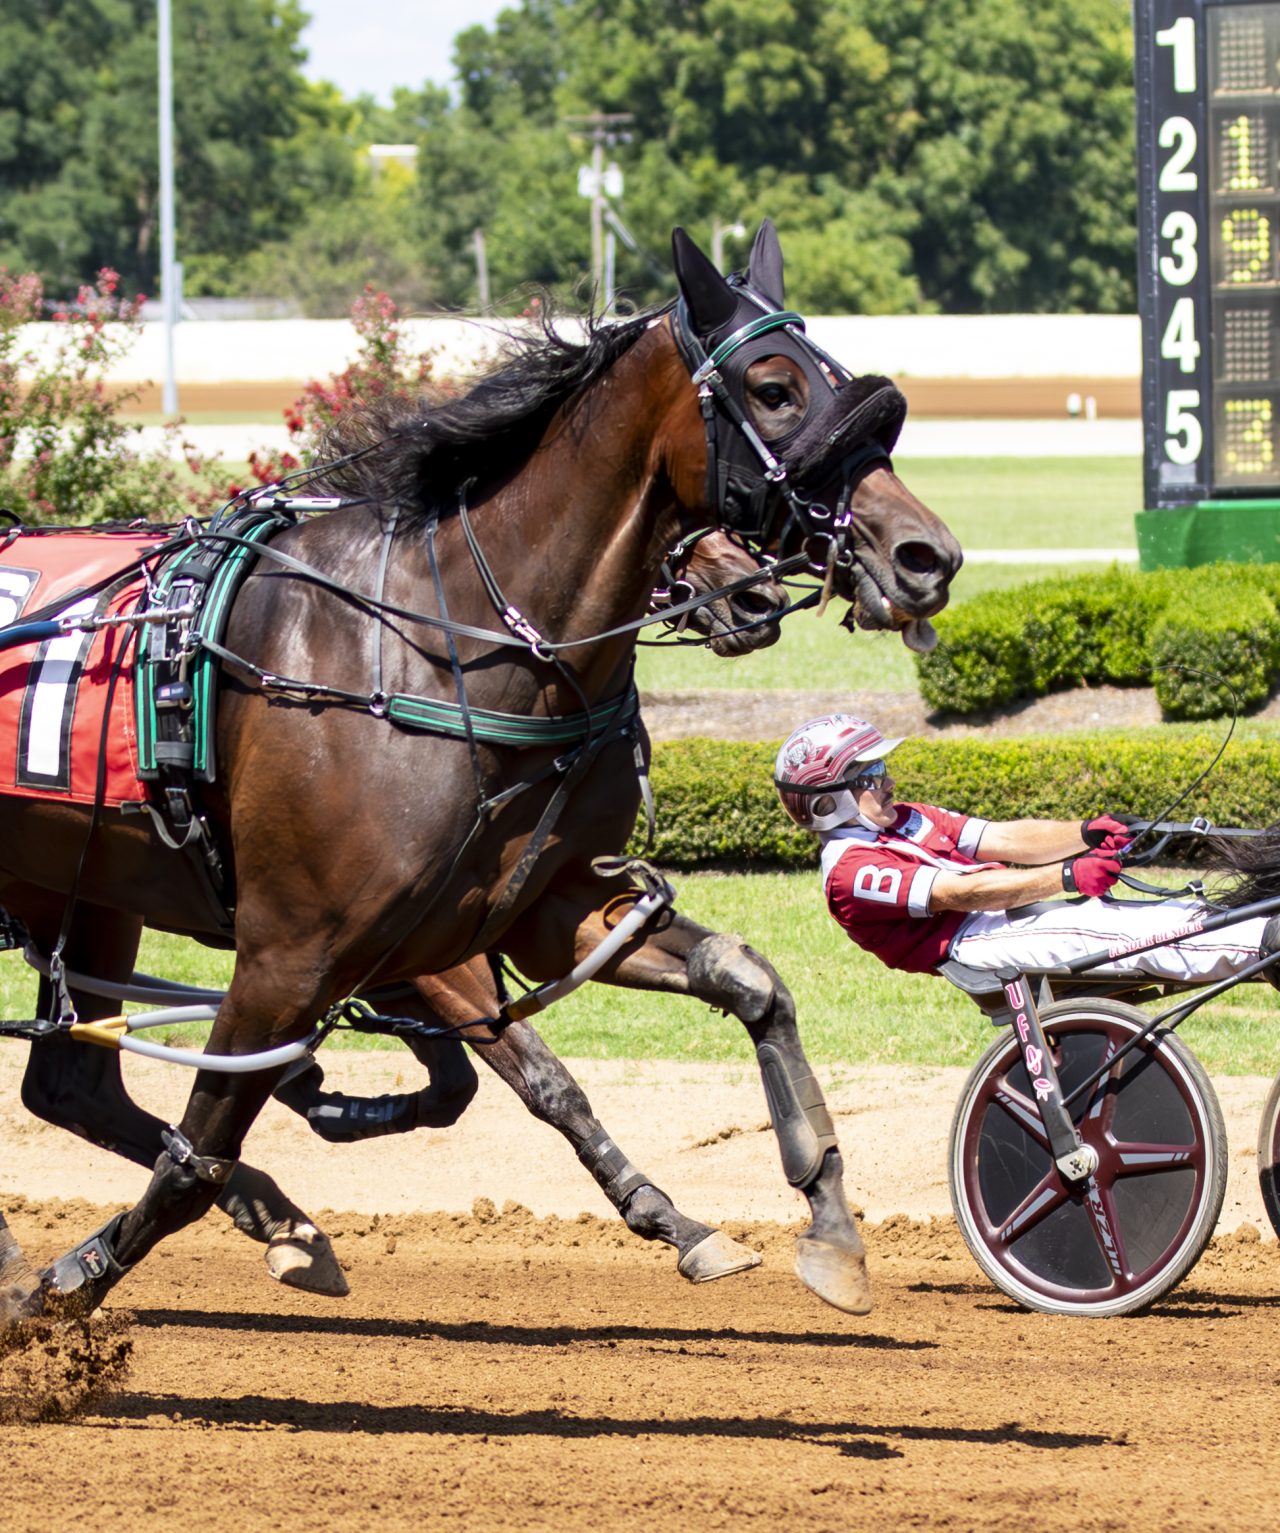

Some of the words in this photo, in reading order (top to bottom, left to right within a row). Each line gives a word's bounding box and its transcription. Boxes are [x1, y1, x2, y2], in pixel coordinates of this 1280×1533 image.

[1155, 17, 1196, 92] 1
[1158, 116, 1197, 191] 2
[1228, 115, 1258, 190] 1
[1160, 211, 1198, 285] 3
[1221, 208, 1269, 282] 9
[1161, 297, 1201, 373] 4
[1164, 390, 1202, 464] 5
[1225, 399, 1273, 472] 3
[27, 597, 100, 776] 1
[853, 863, 903, 905] B
